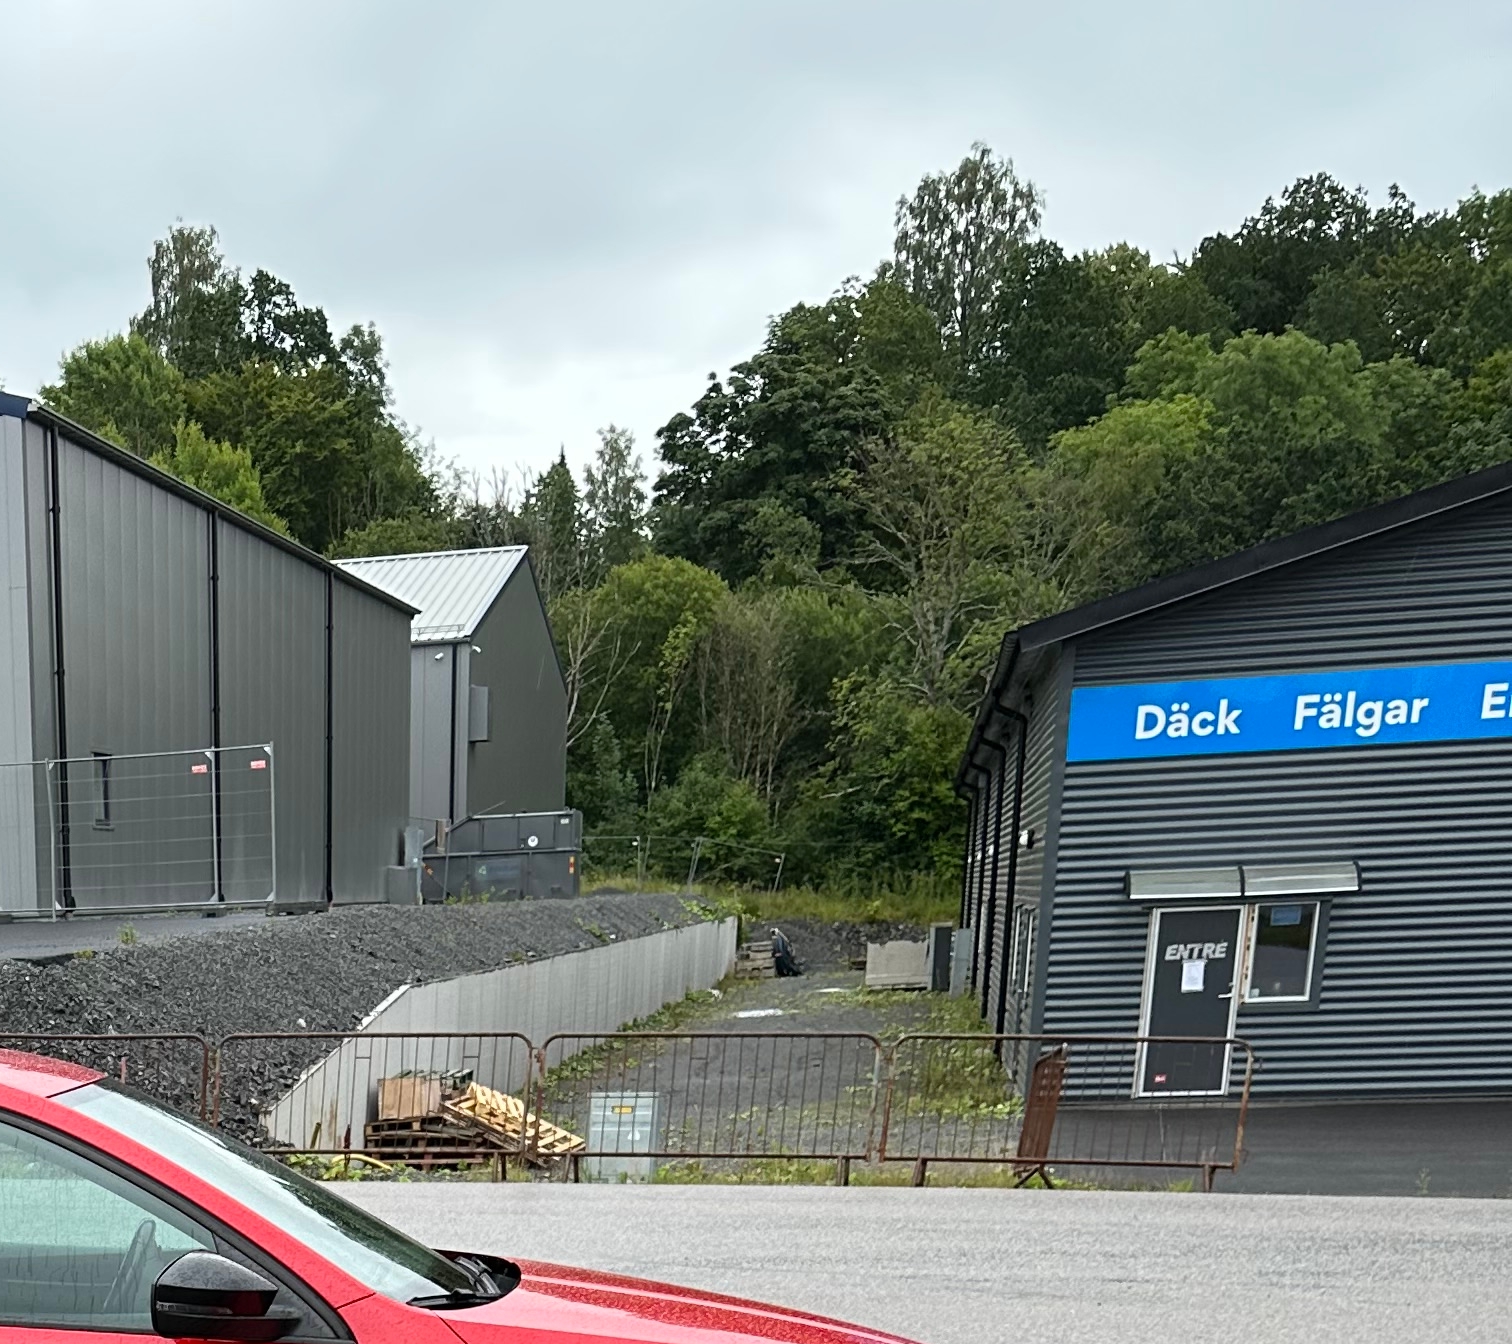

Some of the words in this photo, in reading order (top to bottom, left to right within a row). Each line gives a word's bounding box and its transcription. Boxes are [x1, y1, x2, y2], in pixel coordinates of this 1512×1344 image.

[1134, 698, 1243, 740] Däck
[1293, 690, 1430, 738] Fälgar
[1480, 682, 1512, 720] E
